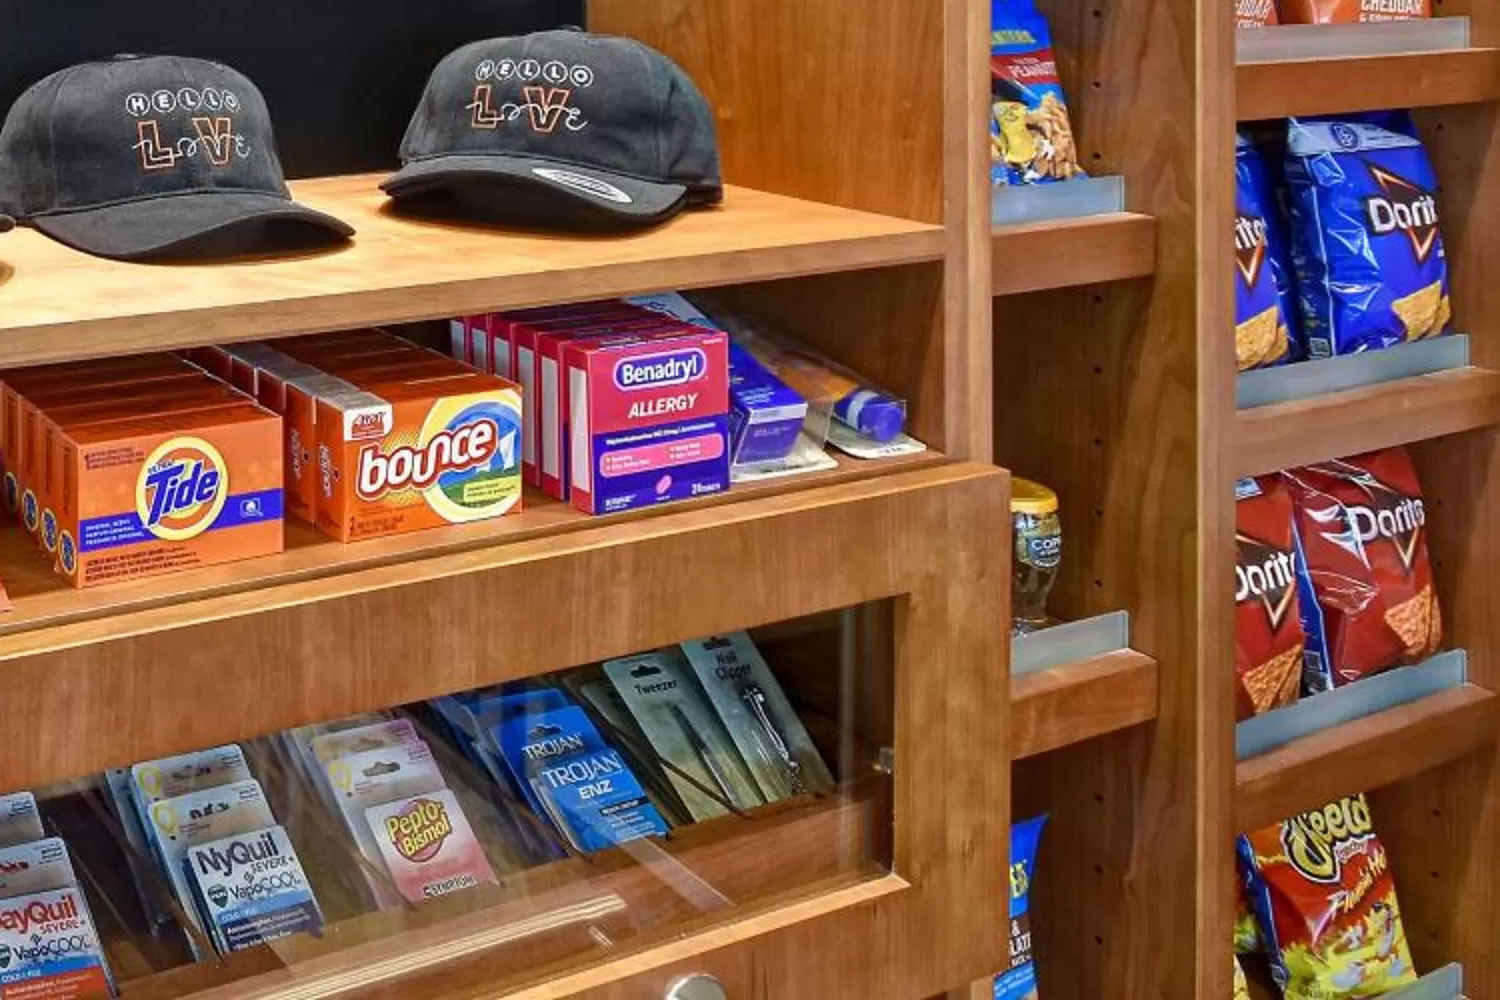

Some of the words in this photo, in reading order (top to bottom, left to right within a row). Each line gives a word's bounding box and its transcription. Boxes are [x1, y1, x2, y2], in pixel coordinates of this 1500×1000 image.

[474, 58, 595, 88] HELLO
[125, 86, 242, 118] HELLO
[1366, 194, 1440, 234] Dorit
[621, 353, 700, 386] Benadryl
[627, 393, 699, 420] ALLERGY
[358, 421, 497, 498] bounce
[145, 461, 220, 527] Tide
[634, 678, 678, 696] Tweezer
[521, 732, 587, 761] TROJAN
[542, 751, 623, 789] TROJAN
[578, 779, 614, 800] ENZ
[401, 811, 451, 858] Bismol
[196, 830, 280, 877] NyQuil
